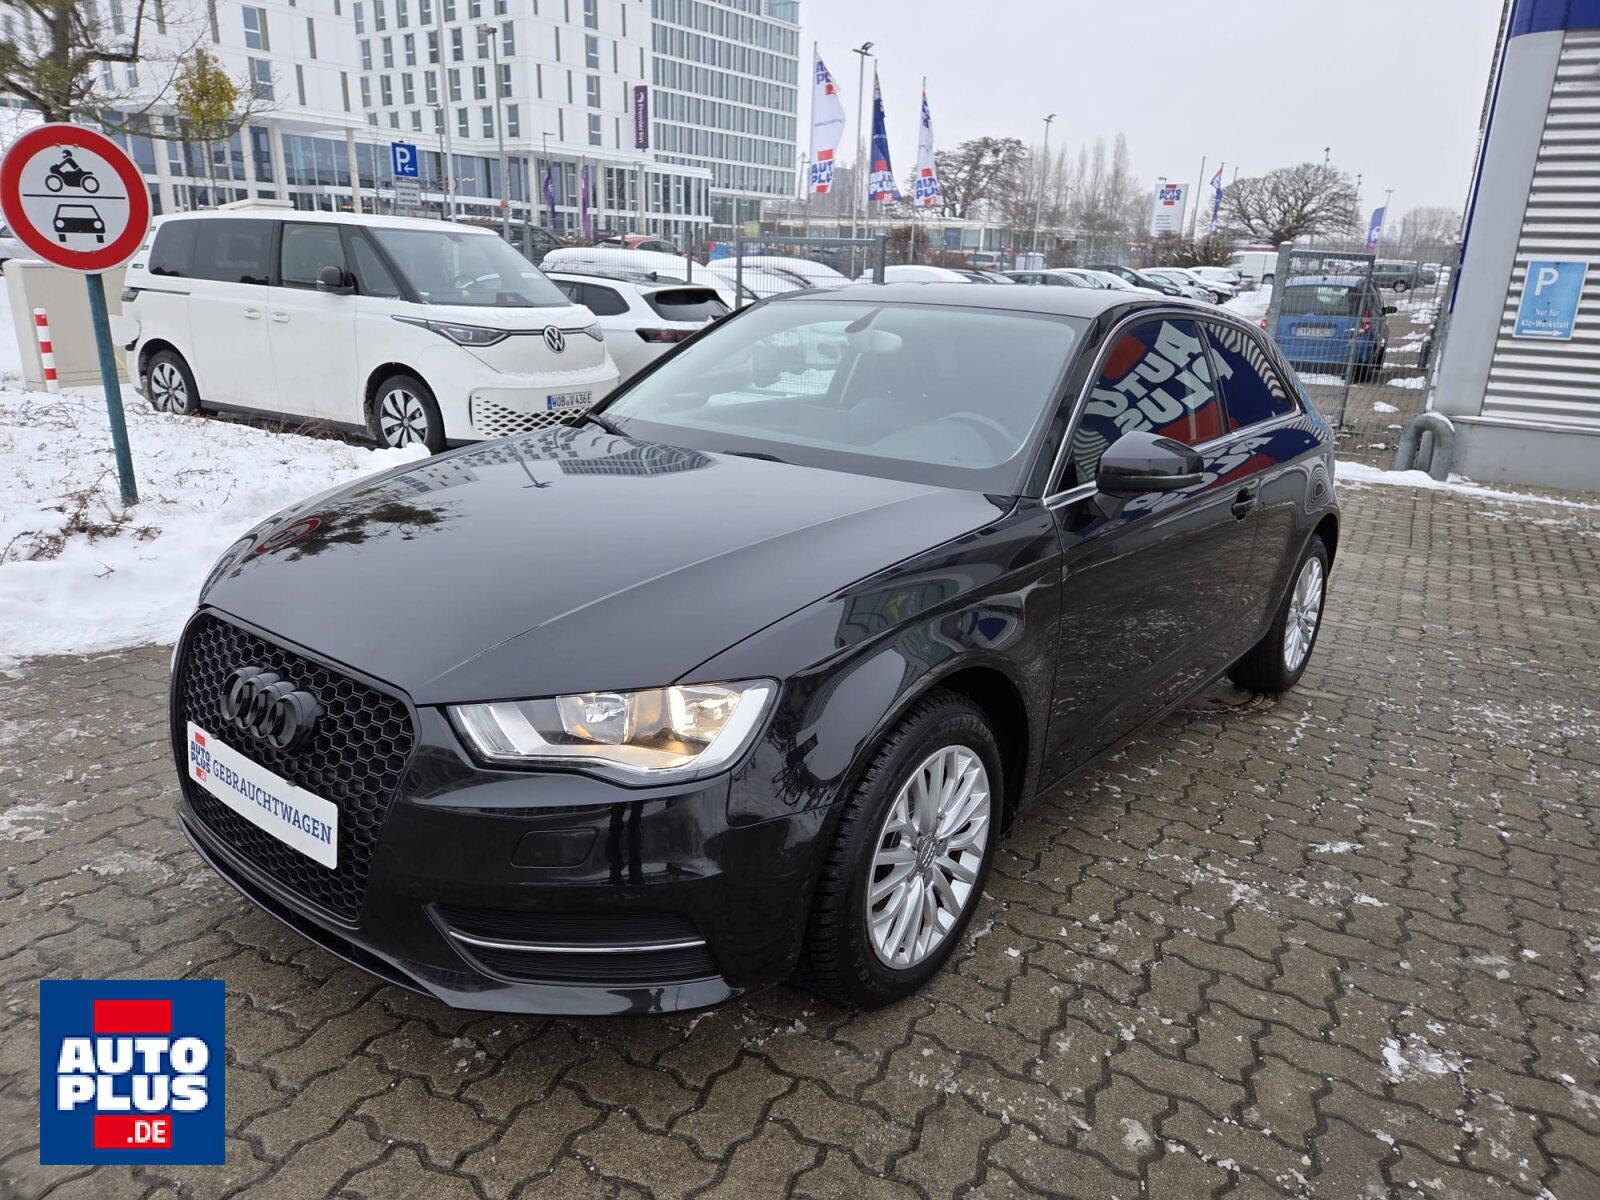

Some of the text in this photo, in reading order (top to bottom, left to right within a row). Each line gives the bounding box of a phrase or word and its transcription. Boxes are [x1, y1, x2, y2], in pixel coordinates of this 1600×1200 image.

[395, 146, 411, 173] P
[1534, 267, 1559, 296] P
[1521, 319, 1570, 329] Kfz-Werkstatt
[190, 741, 211, 762] AUTO
[190, 752, 211, 774] PLUS
[212, 759, 332, 845] GEBRAUCHTWAGEN
